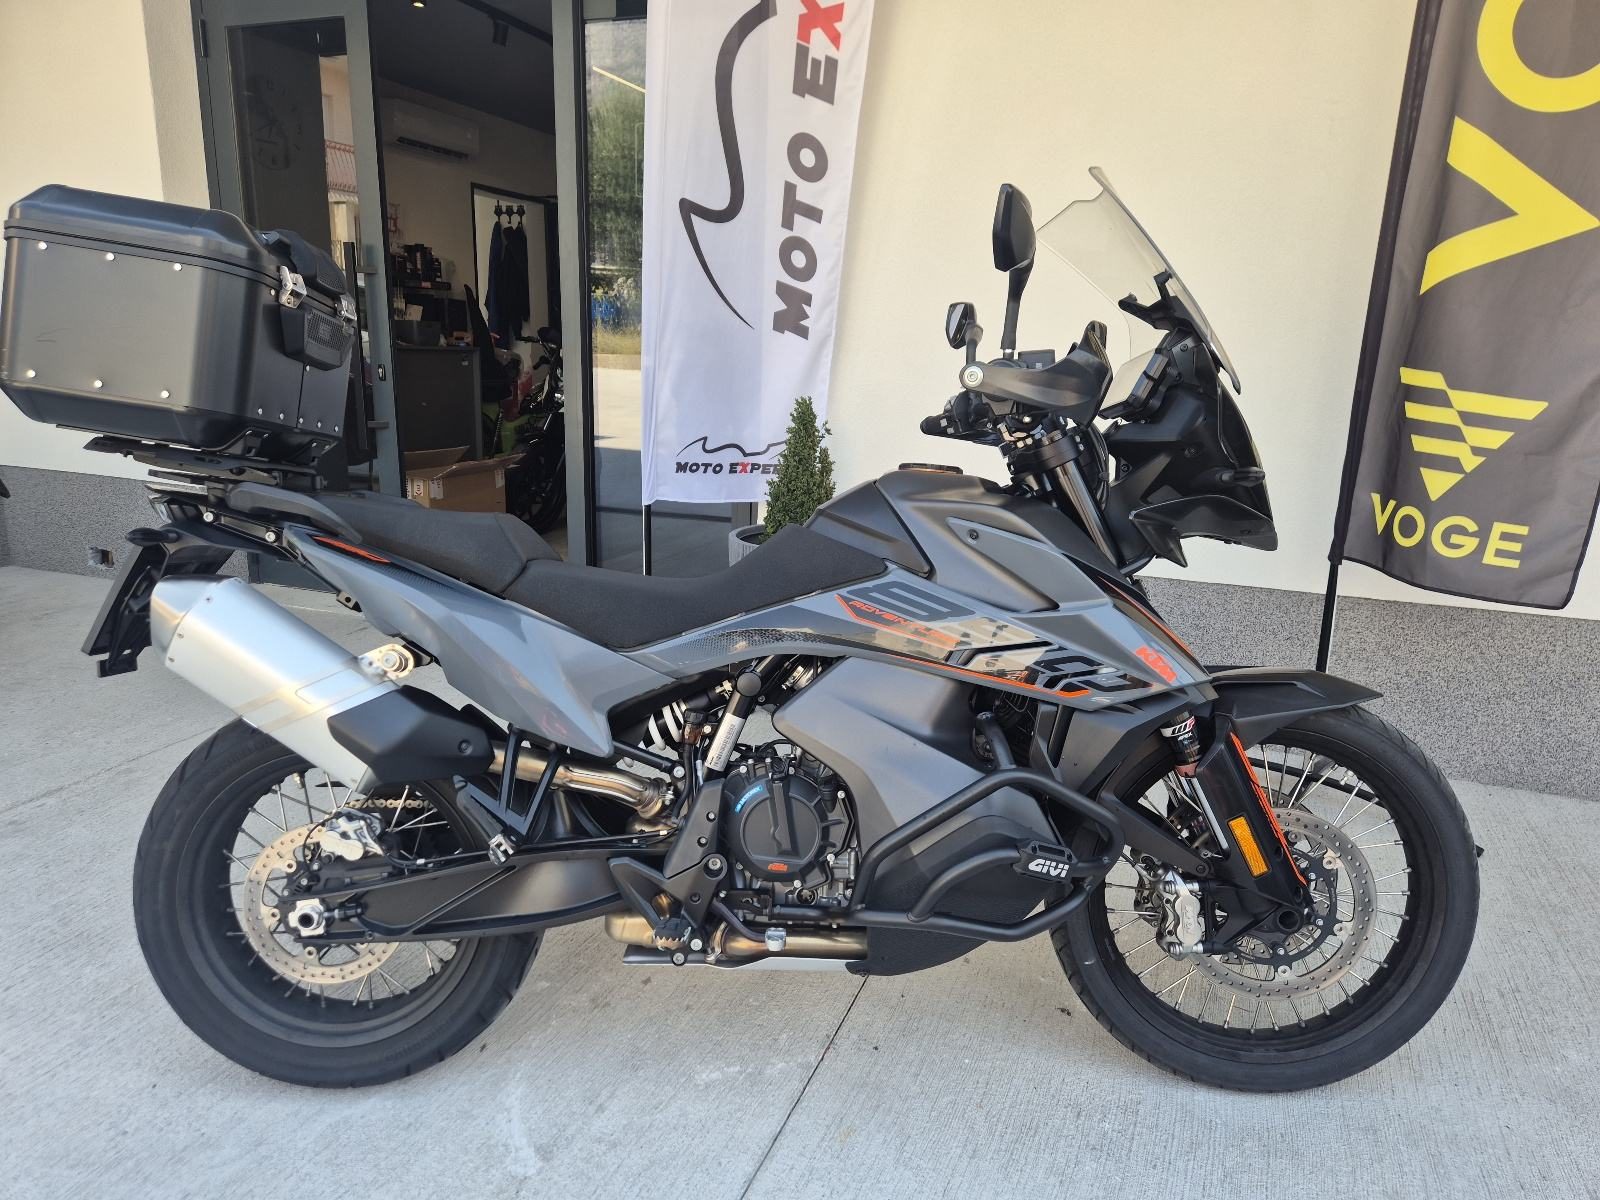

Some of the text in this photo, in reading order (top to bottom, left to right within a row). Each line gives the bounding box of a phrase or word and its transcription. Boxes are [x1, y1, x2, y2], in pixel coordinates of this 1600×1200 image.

[772, 132, 829, 341] MOTO
[675, 461, 724, 475] MOTO
[1370, 492, 1530, 569] VOGE
[1028, 858, 1070, 878] GIVI
